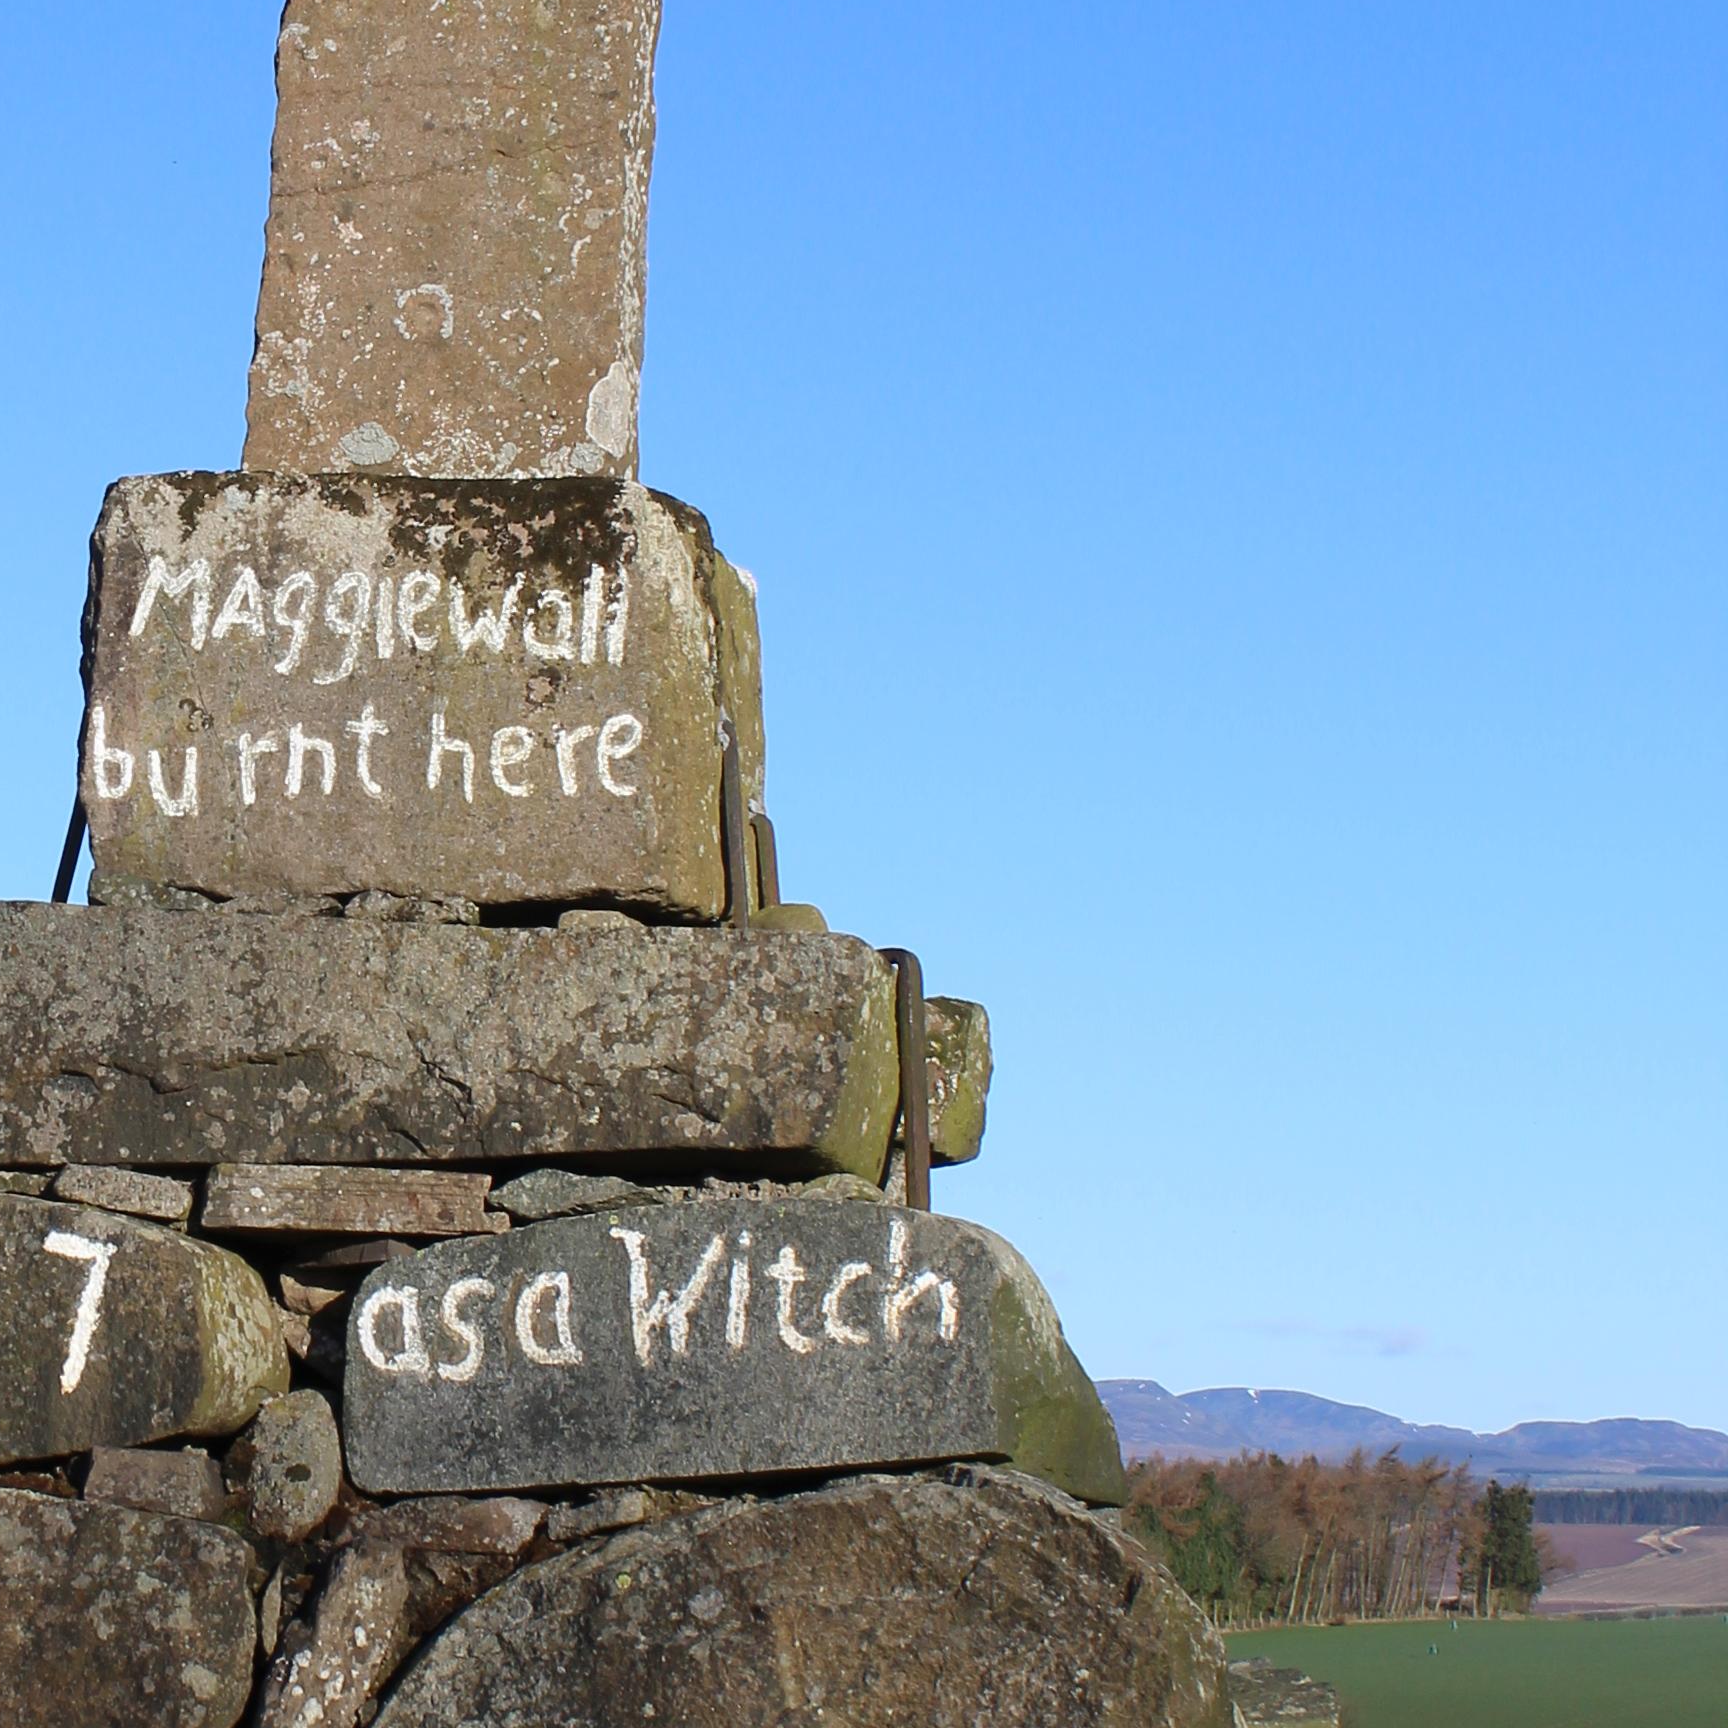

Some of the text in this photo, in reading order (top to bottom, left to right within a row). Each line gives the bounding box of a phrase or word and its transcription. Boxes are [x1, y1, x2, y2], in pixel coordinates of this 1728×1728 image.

[92, 700, 645, 817] burnt here
[610, 1218, 961, 1368] Witch
